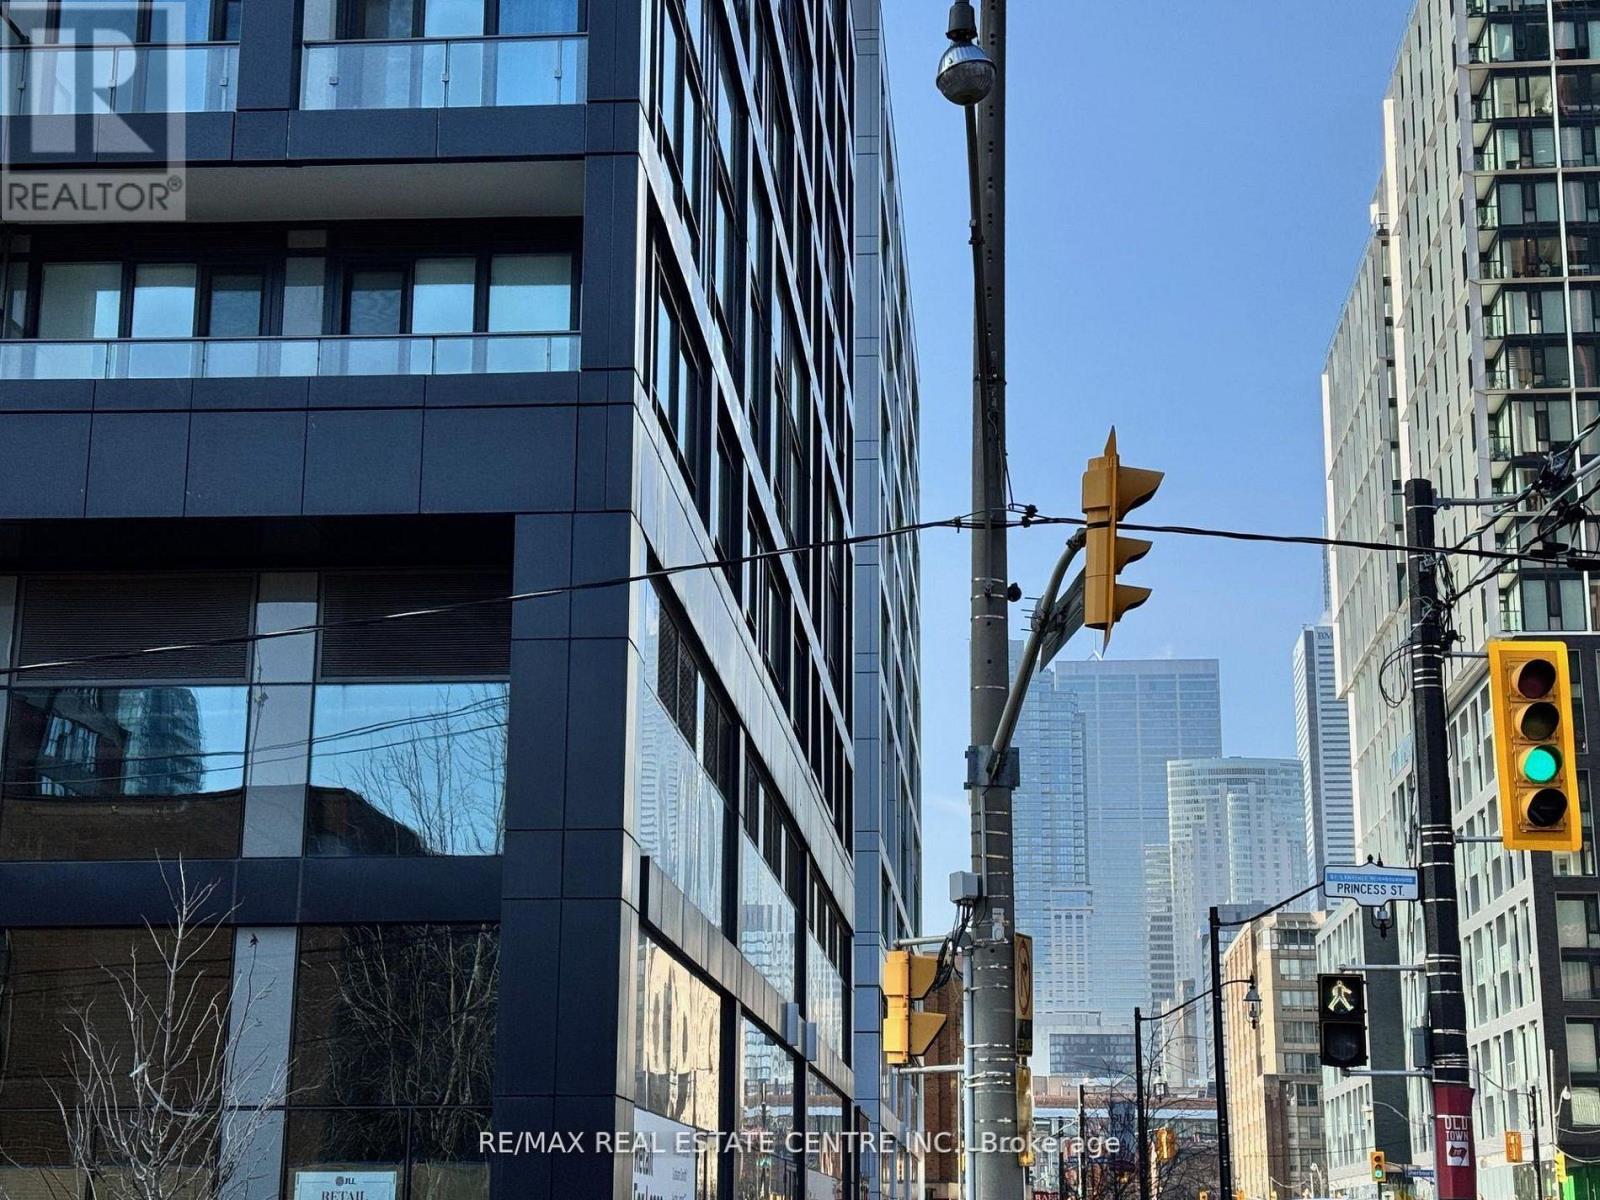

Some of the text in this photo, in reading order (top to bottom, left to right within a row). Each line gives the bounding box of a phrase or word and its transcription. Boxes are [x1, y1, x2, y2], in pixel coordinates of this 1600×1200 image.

[1317, 631, 1334, 640] BM
[1337, 883, 1387, 895] PRINCESS
[1445, 1116, 1468, 1130] OLD
[1445, 1131, 1469, 1141] TOWN
